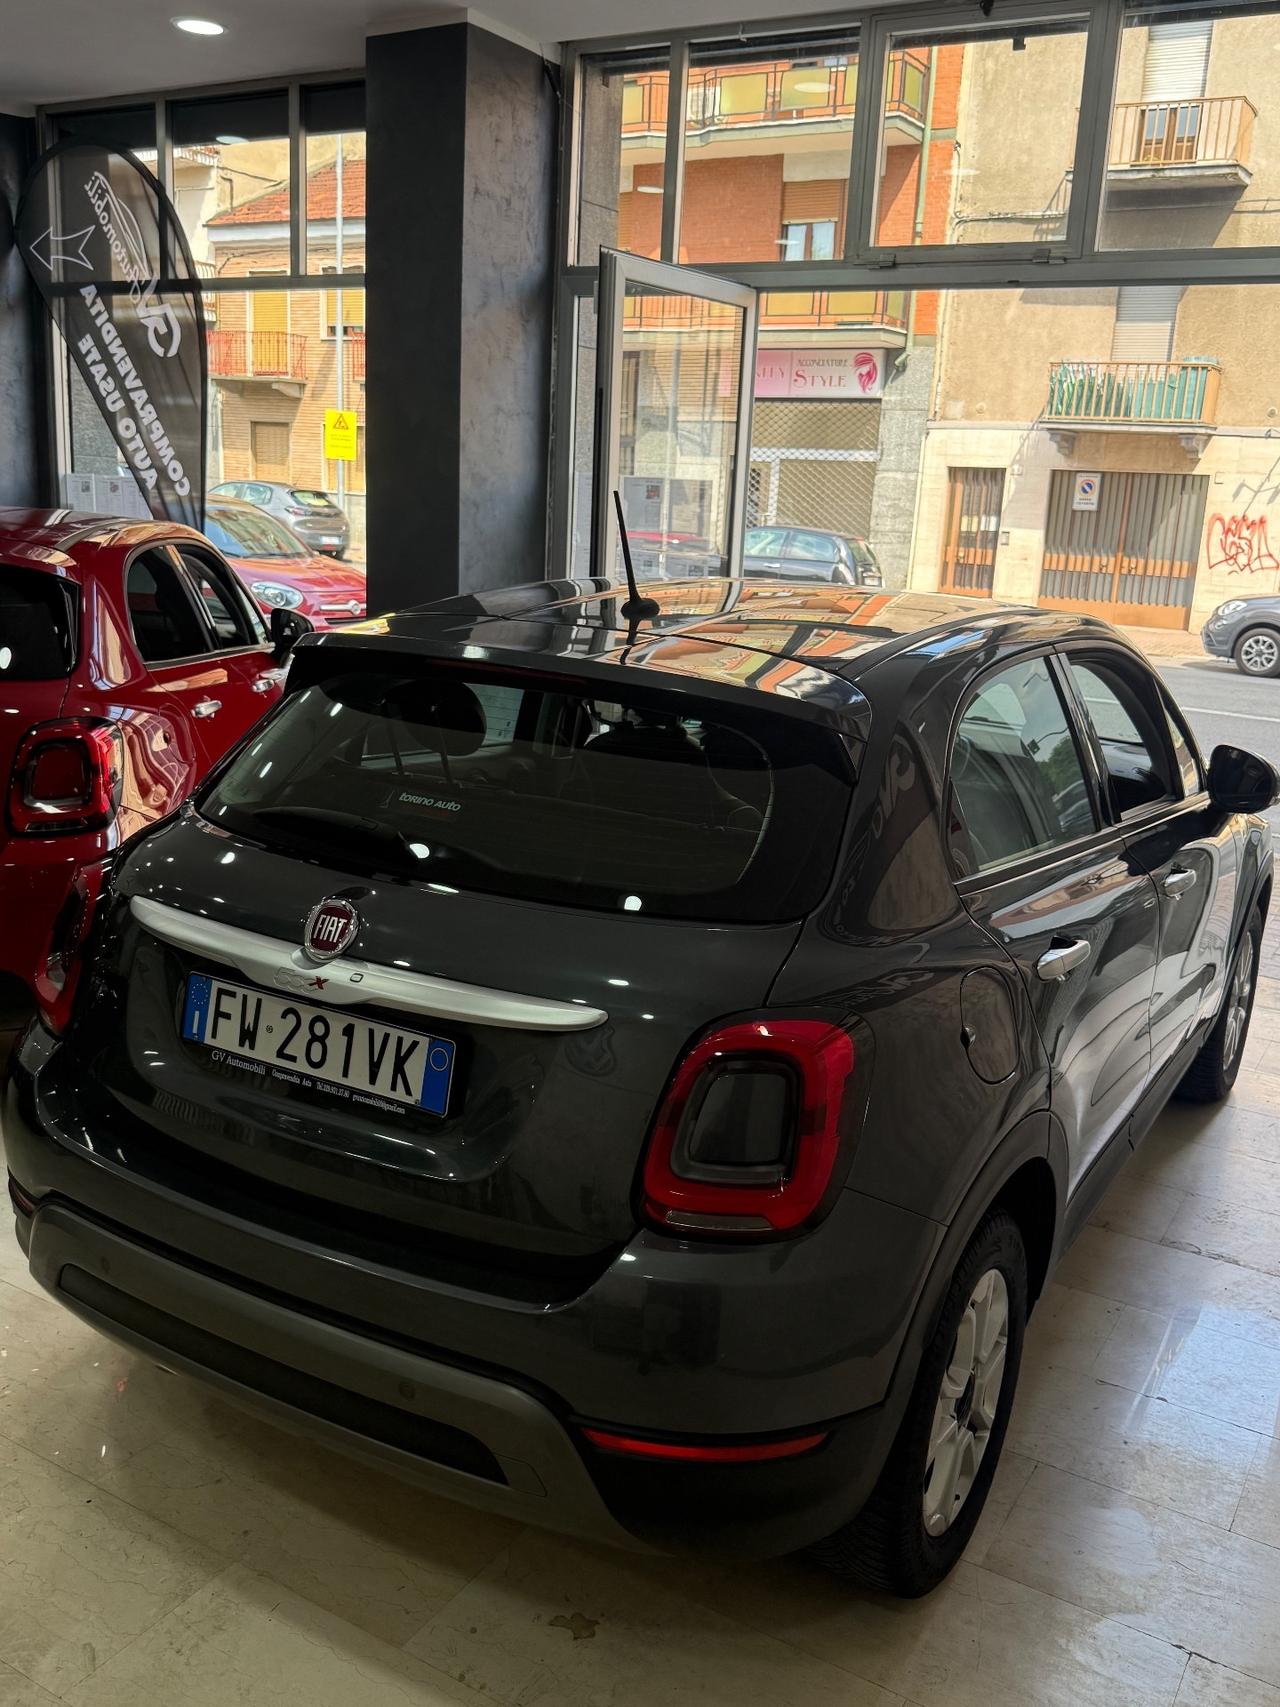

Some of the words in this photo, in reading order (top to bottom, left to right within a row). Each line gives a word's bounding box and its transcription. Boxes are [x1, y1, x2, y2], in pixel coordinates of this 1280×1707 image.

[793, 369, 847, 388] STYLE
[313, 914, 348, 943] FIAT
[211, 987, 262, 1050] FW
[276, 1007, 420, 1097] 281VK
[211, 1050, 226, 1062] GV
[226, 1056, 266, 1075] Automobili
